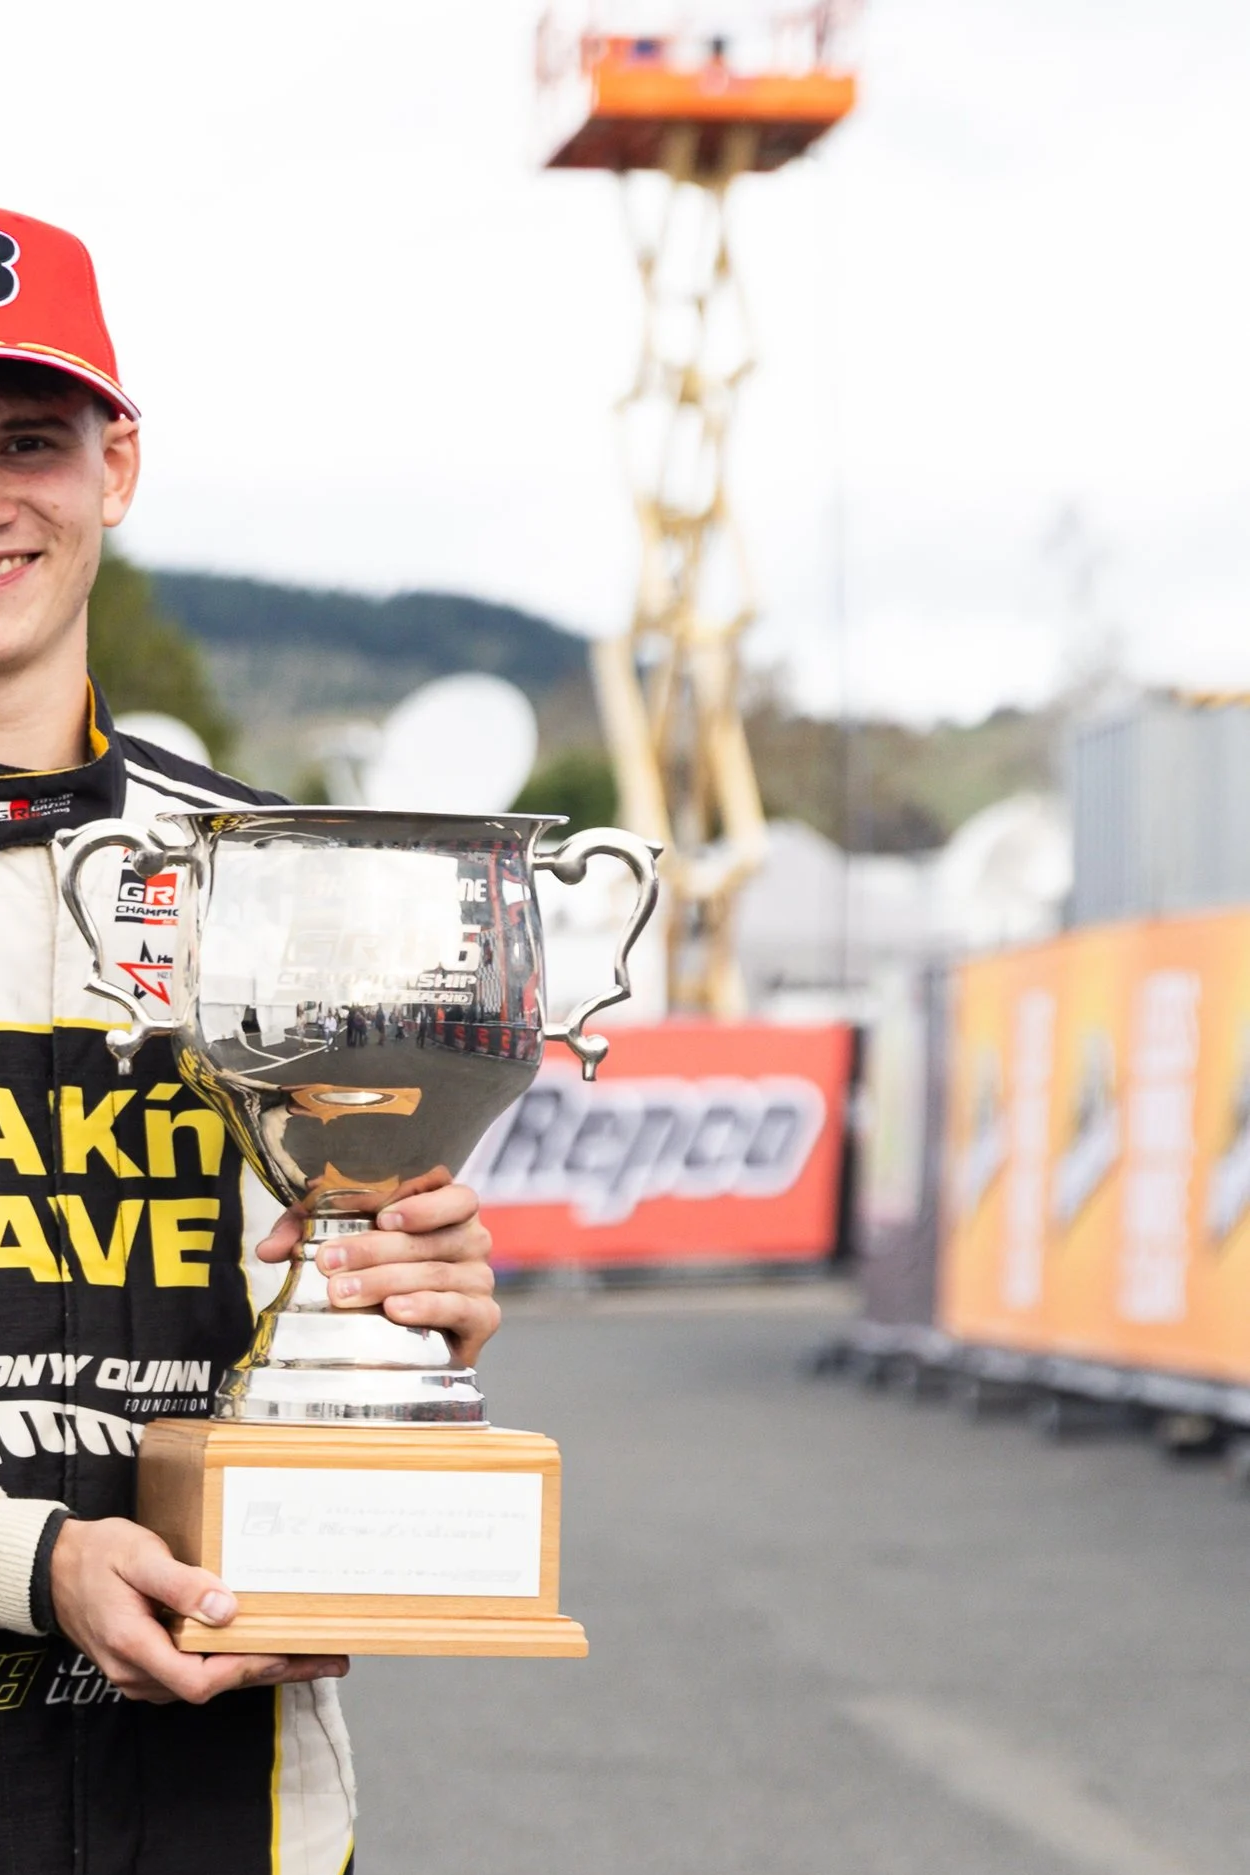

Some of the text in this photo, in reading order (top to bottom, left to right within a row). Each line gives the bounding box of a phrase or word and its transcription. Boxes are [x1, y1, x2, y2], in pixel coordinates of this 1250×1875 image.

[119, 882, 174, 905] GR
[95, 1358, 211, 1393] QUINN
[124, 1398, 209, 1413] FOUNDATION
